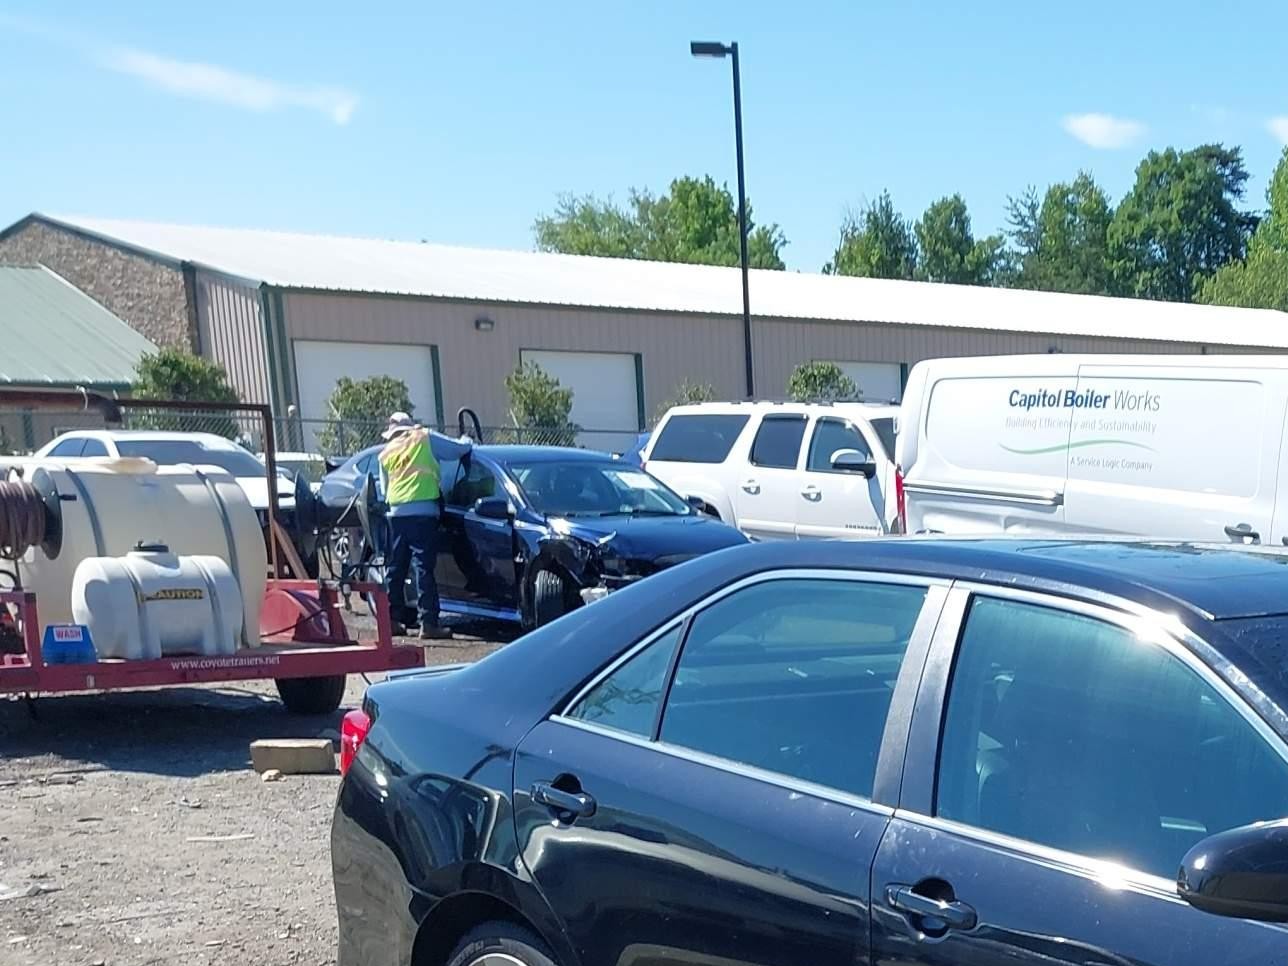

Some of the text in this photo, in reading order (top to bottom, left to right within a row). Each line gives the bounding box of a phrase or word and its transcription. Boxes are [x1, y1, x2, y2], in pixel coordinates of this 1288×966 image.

[1009, 388, 1161, 412] Capitol Boiler Works
[1005, 417, 1037, 430] Building
[1080, 420, 1096, 431] and
[1098, 419, 1156, 434] Sustainability
[1076, 456, 1101, 467] Service
[1101, 457, 1120, 469] Logic
[1120, 458, 1153, 472] Company
